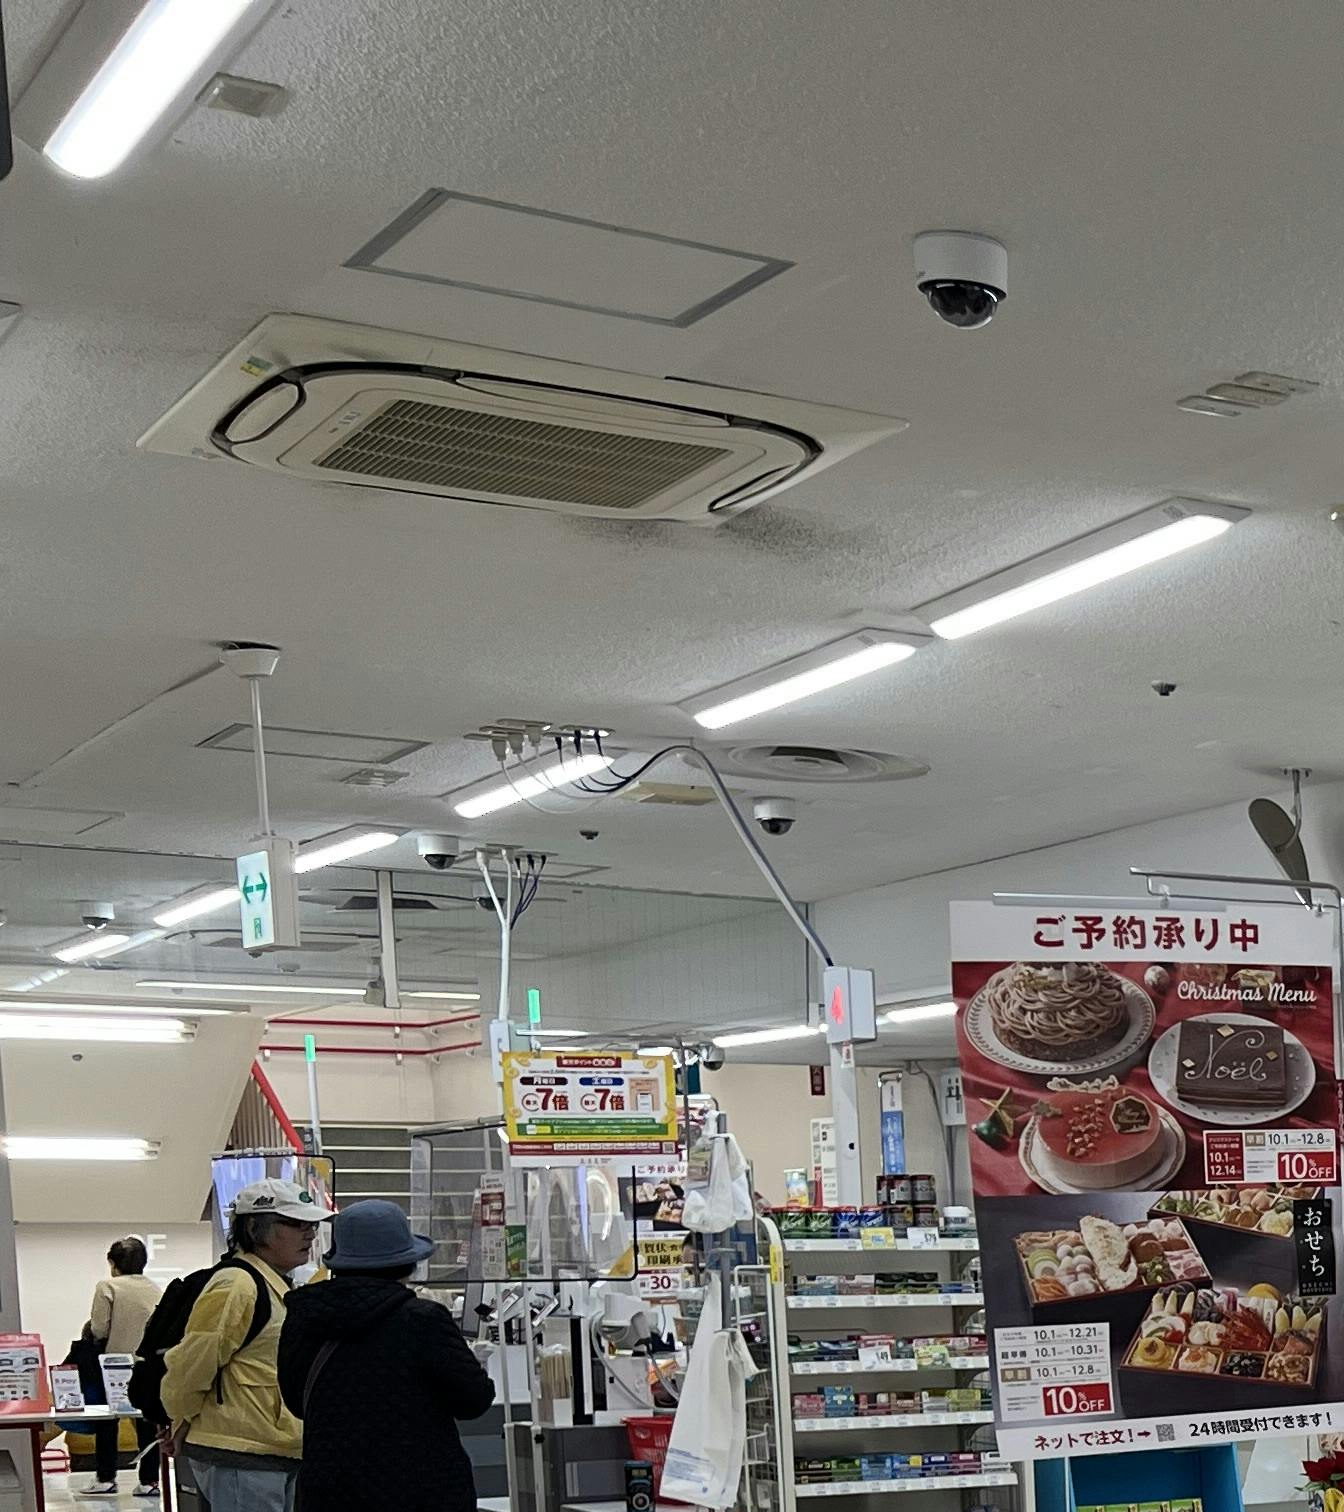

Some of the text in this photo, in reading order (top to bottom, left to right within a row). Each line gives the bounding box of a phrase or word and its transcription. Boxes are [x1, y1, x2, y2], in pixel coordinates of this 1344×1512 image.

[1034, 915, 1260, 952] ご予約承り中
[1177, 980, 1317, 1003] Christmas Menu
[536, 1088, 569, 1111] 7倍
[594, 1088, 625, 1111] 7倍
[1268, 1133, 1289, 1146] 10.1
[1301, 1133, 1325, 1145] 12.8
[1208, 1151, 1229, 1163] 10.1
[1209, 1165, 1236, 1176] 12.14
[1303, 1207, 1325, 1277] おせち
[650, 1275, 672, 1290] 30
[1034, 1327, 1097, 1340] 10.1 12.21
[1035, 1347, 1057, 1358] 10.1
[1072, 1344, 1098, 1355] 10.31
[1037, 1367, 1058, 1378] 10.1
[1072, 1365, 1094, 1375] 12.8
